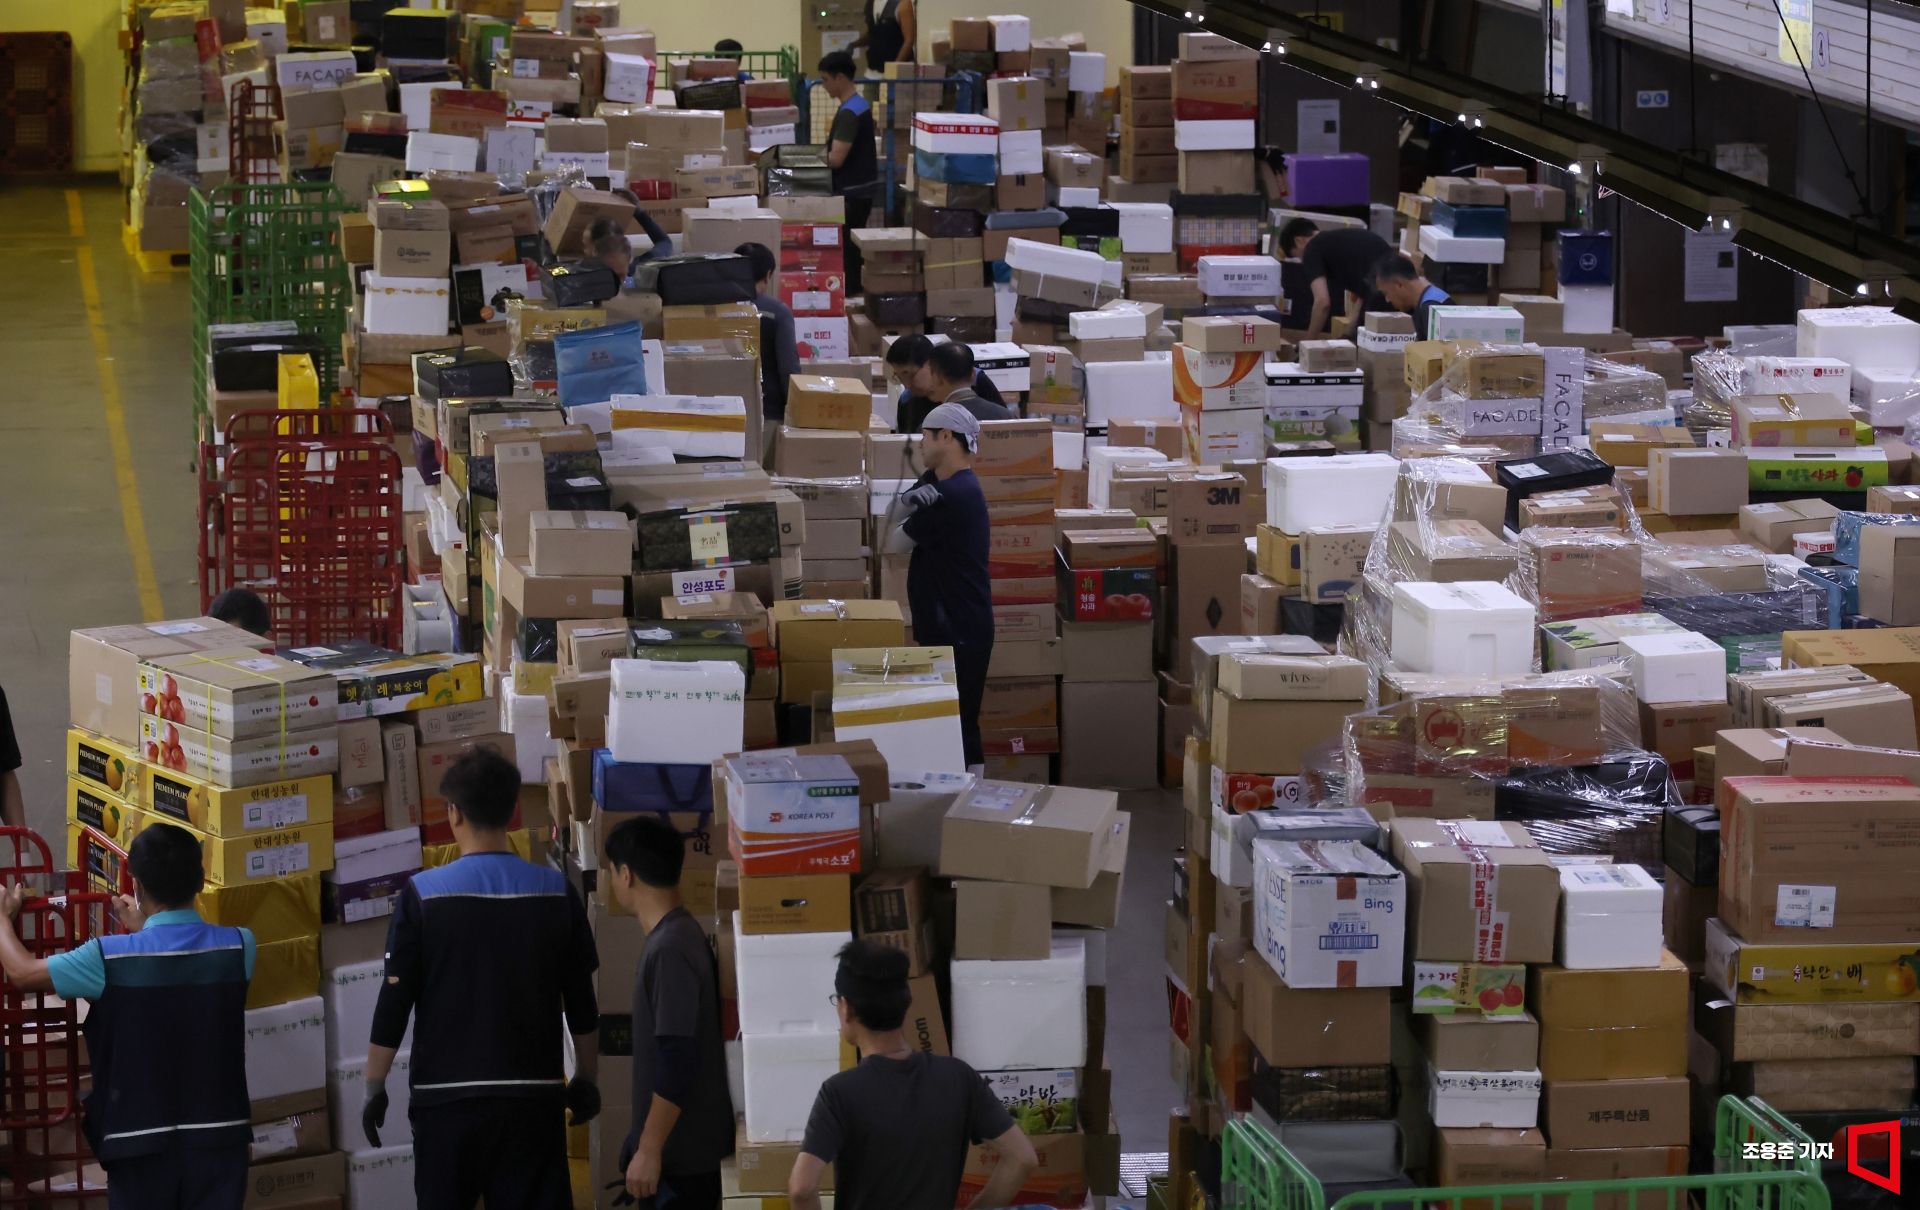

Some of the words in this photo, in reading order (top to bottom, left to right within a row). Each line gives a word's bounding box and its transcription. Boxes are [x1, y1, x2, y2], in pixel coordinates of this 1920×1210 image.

[296, 68, 353, 83] FACADE
[1473, 409, 1537, 424] FACADE
[1207, 488, 1240, 505] 3M
[683, 581, 725, 594] 안성포도
[1080, 594, 1096, 602] 청송
[1080, 603, 1095, 611] 사과
[394, 680, 423, 694] 복숭아
[79, 749, 97, 762] PREMIUM
[155, 782, 174, 795] PREMIUM
[78, 796, 93, 809] PREMIUM
[788, 811, 813, 821] KOREA
[815, 811, 834, 820] POST
[830, 855, 850, 866] 소포
[1364, 897, 1394, 914] Bing
[1267, 926, 1286, 978] Bing
[1803, 966, 1830, 980] 낙안
[1847, 963, 1862, 983] 배
[1020, 1084, 1061, 1109] 알밤
[1588, 1109, 1650, 1123] 제주특산품
